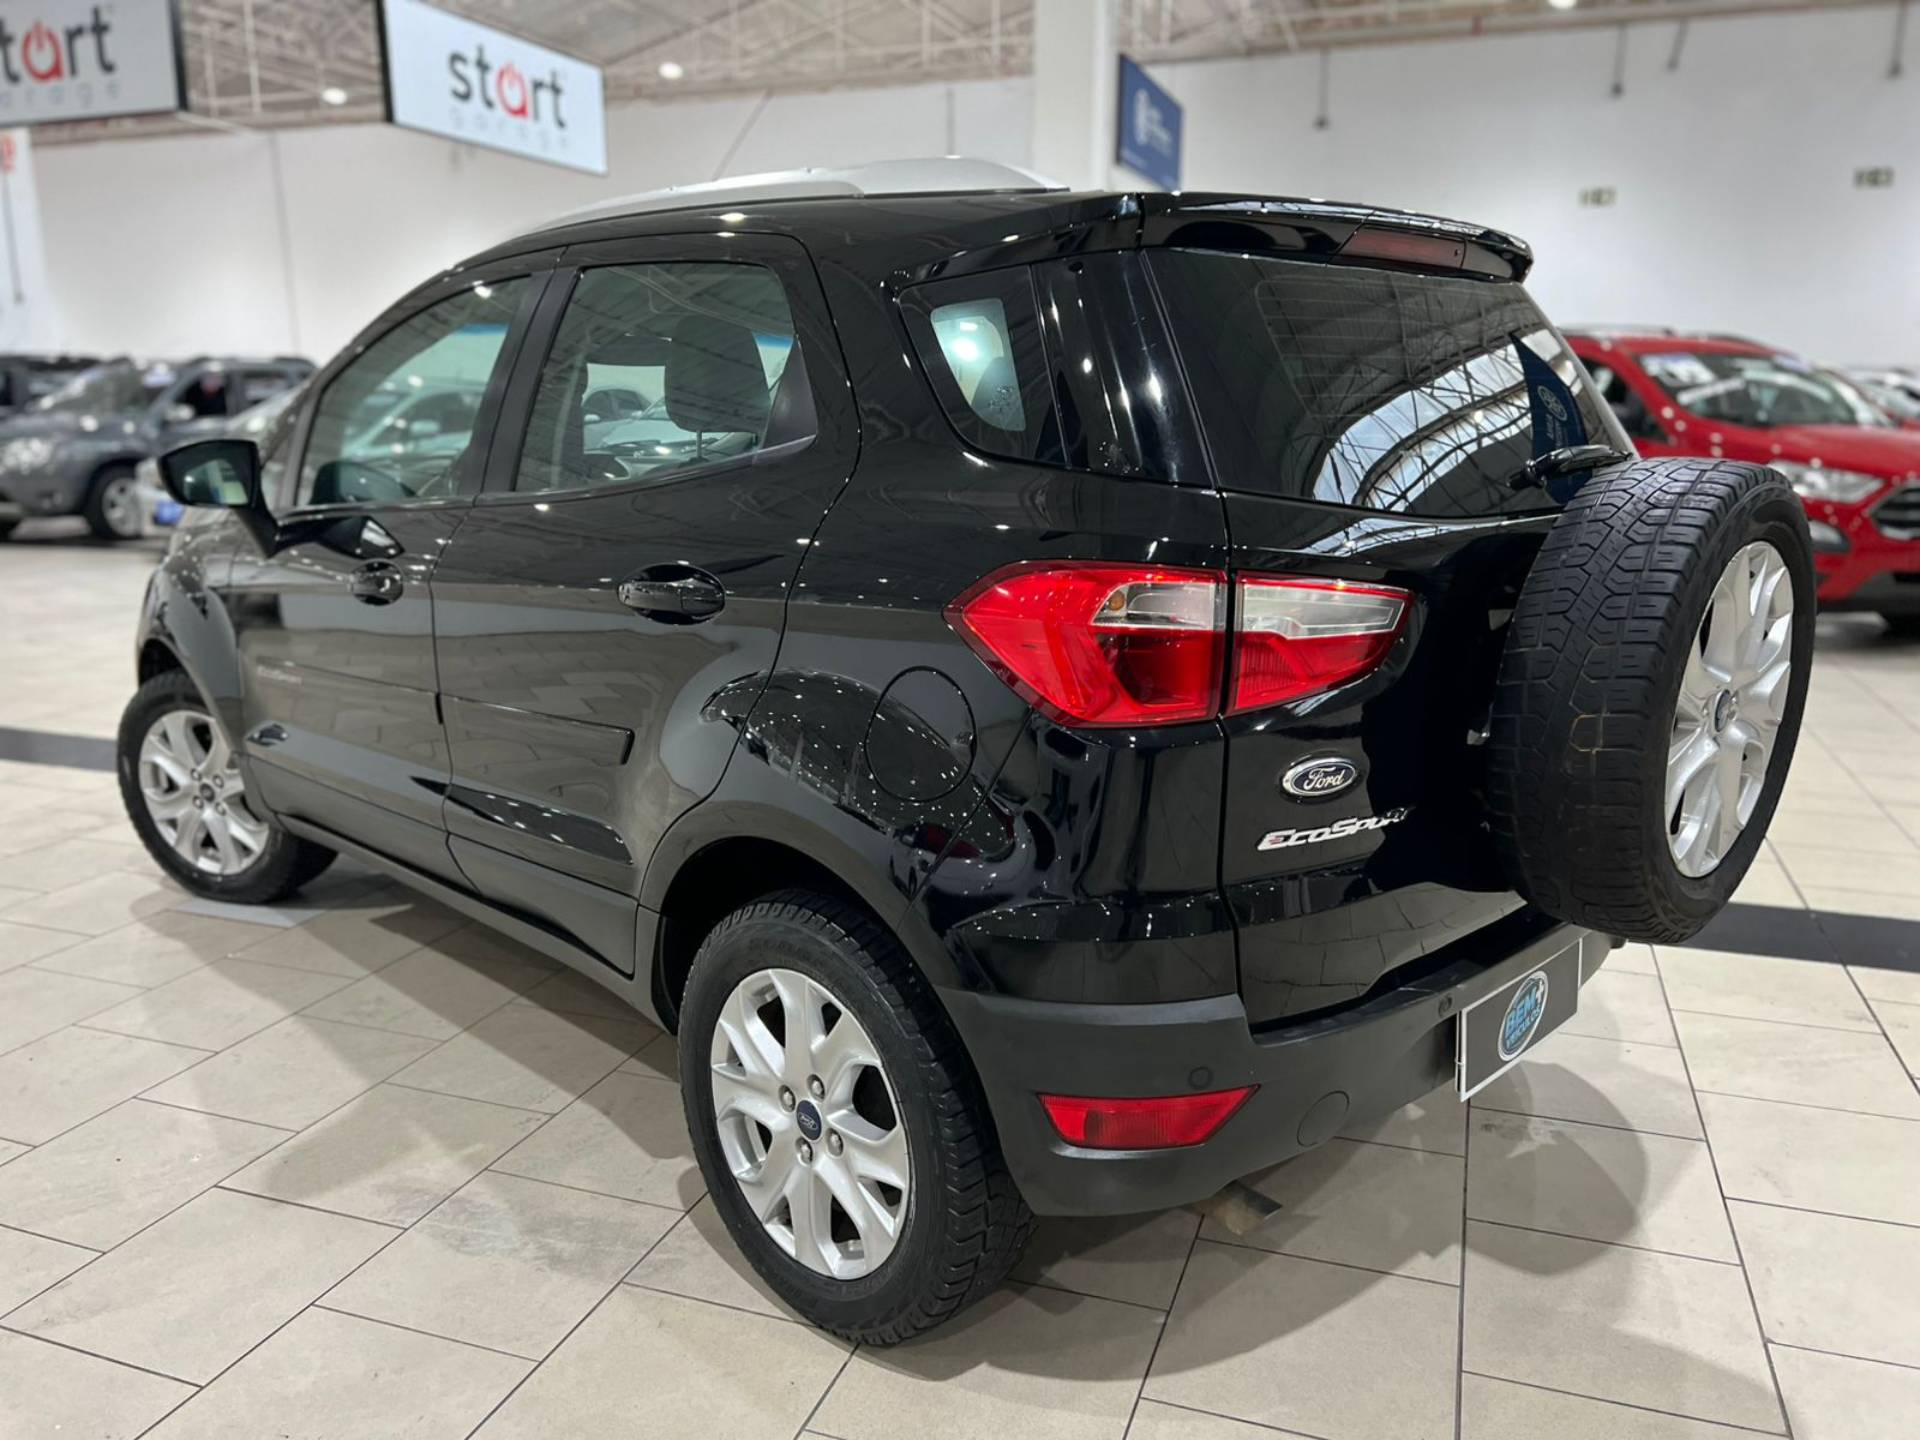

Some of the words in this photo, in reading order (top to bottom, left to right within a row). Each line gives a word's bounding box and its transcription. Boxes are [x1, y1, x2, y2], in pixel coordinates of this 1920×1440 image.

[0, 5, 115, 84] tart
[448, 43, 567, 129] start
[1303, 766, 1346, 791] Ford
